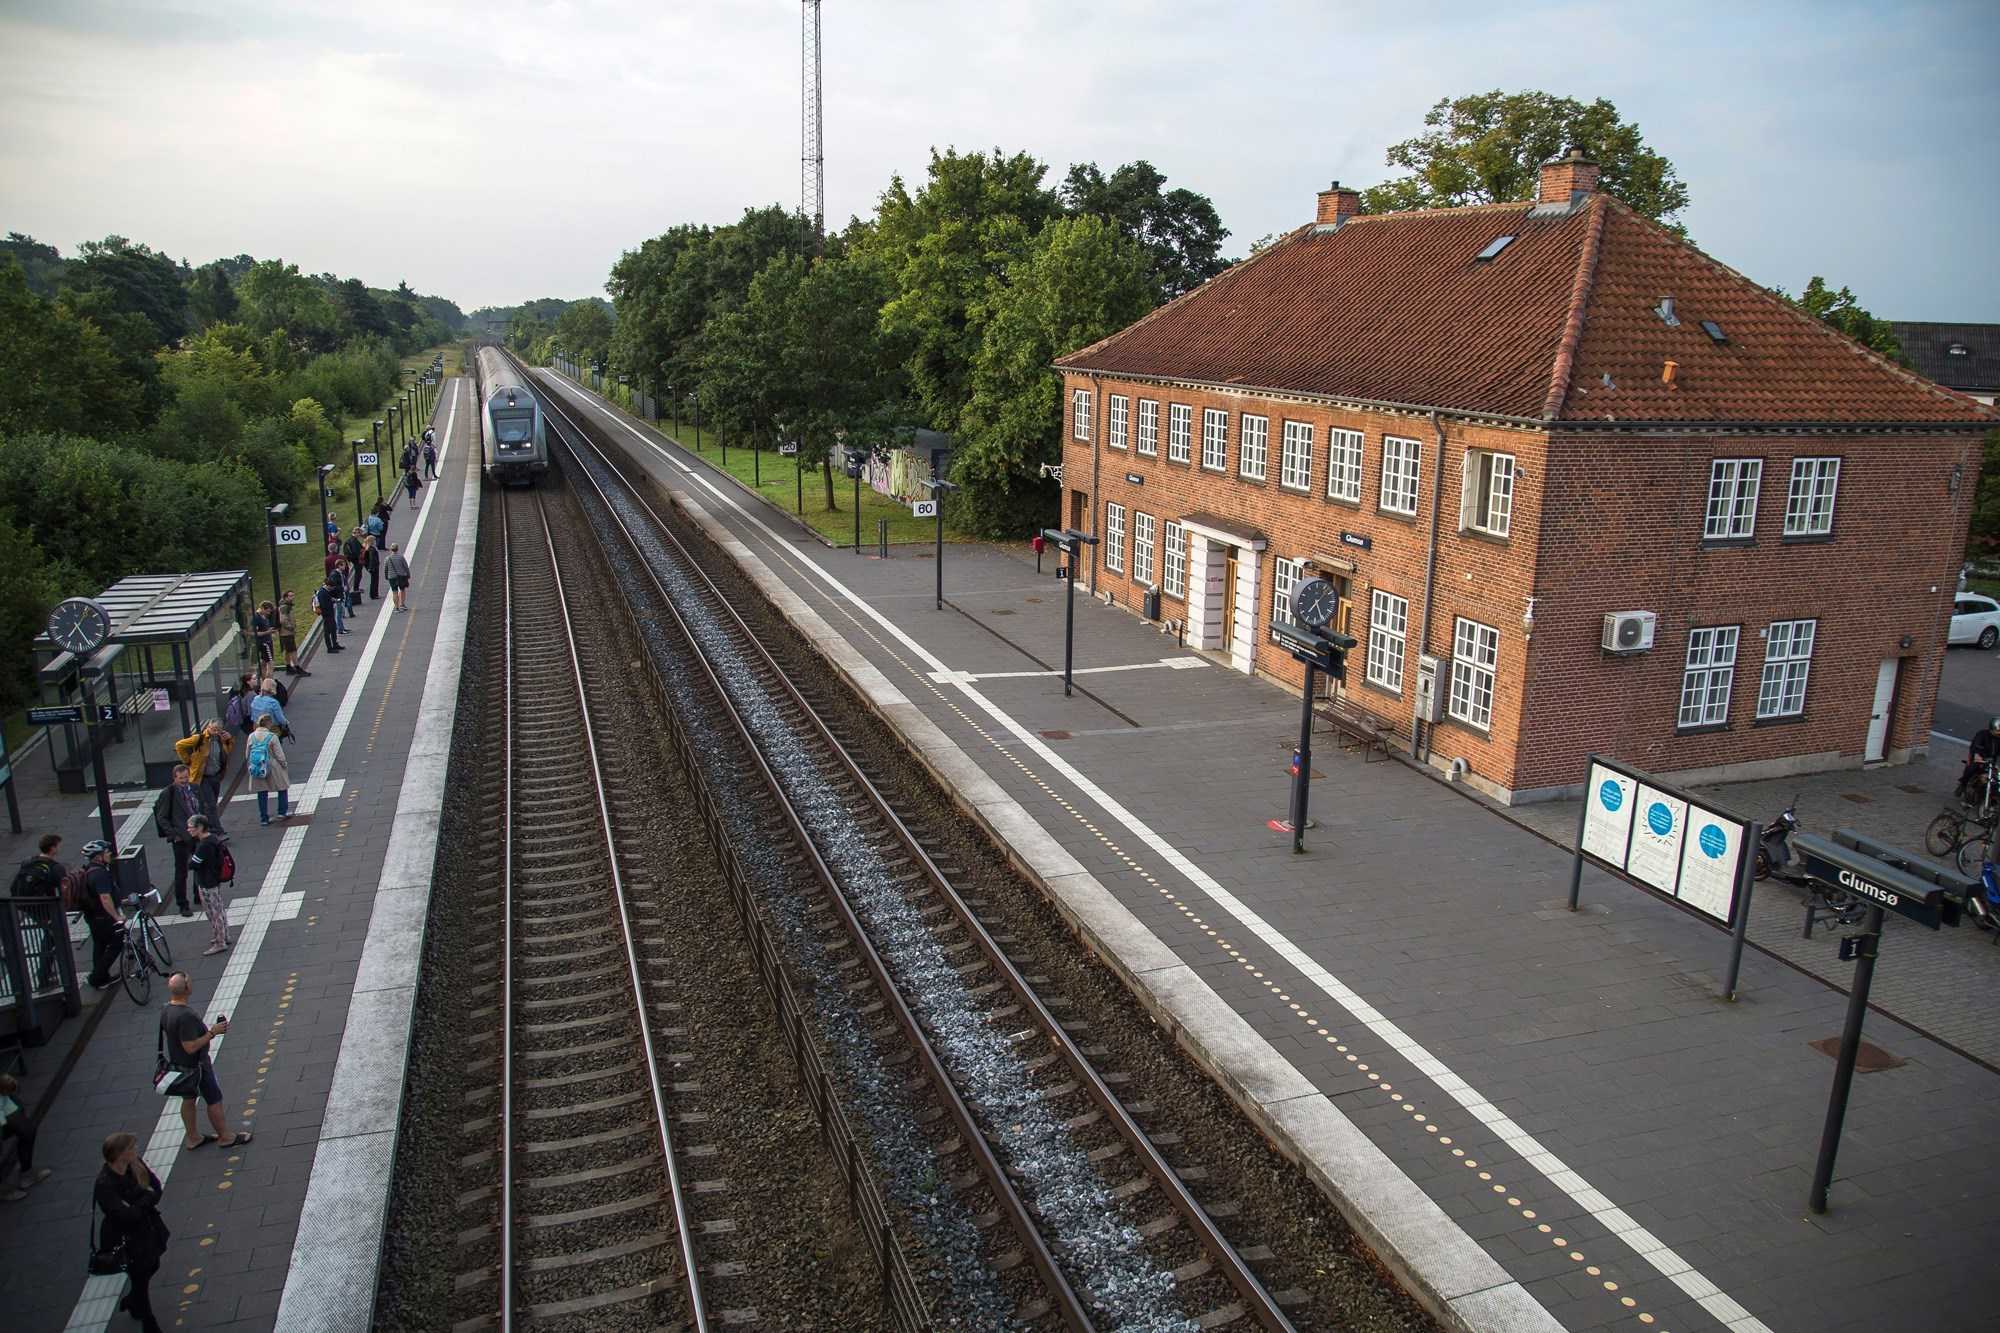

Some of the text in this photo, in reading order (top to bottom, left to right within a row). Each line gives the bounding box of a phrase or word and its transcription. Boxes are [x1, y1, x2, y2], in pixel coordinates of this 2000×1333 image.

[360, 454, 376, 463] 120
[918, 503, 933, 514] 60
[281, 529, 301, 541] 60
[104, 709, 113, 720] 2
[1839, 870, 1898, 906] Glumsø
[1849, 943, 1857, 957] 1
